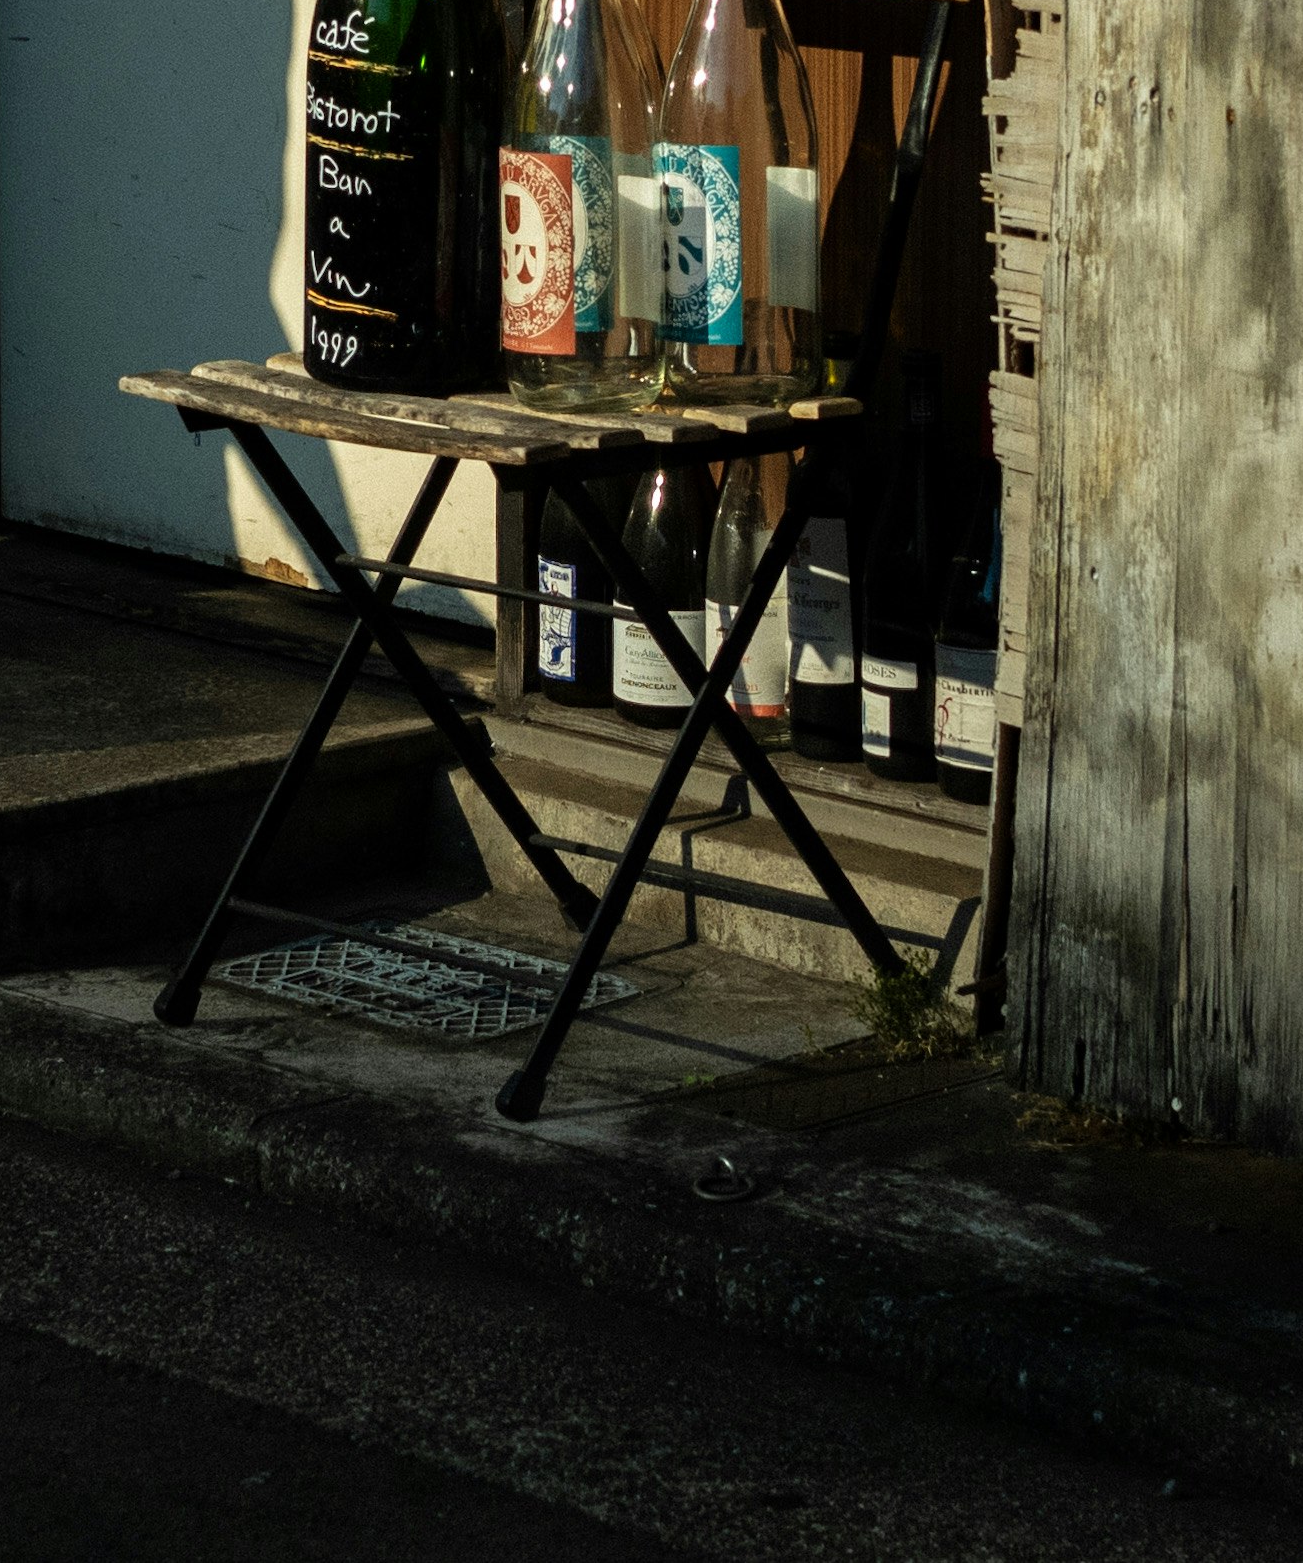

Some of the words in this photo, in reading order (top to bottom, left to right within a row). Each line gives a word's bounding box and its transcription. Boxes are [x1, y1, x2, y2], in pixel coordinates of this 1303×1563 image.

[316, 9, 376, 54] café
[330, 216, 350, 239] a
[311, 249, 371, 297] Vin
[311, 316, 358, 367] 1999
